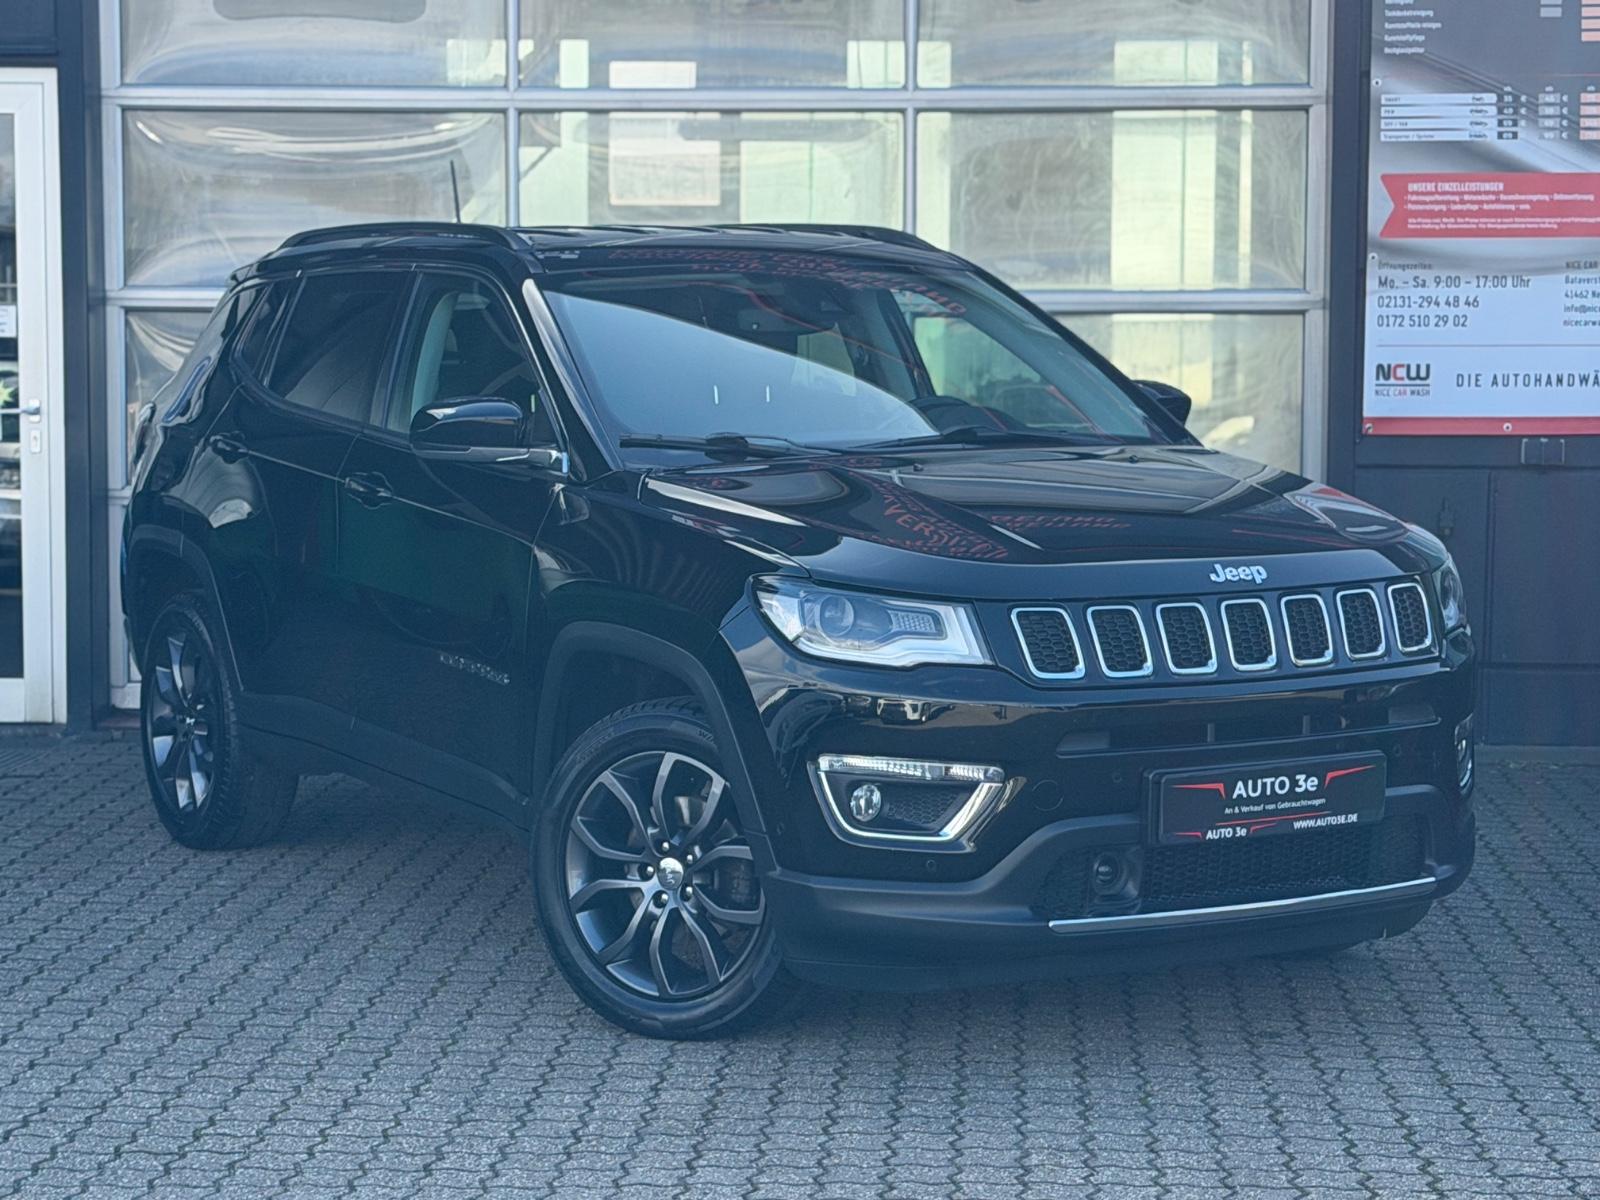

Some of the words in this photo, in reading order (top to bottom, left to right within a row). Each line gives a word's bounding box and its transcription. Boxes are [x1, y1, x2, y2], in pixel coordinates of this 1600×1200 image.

[1378, 275, 1399, 289] Mo.
[1412, 275, 1430, 289] Sa.
[1434, 275, 1462, 289] 9:00
[1475, 275, 1508, 288] 17:00
[1512, 275, 1531, 288] Uhr
[1377, 295, 1441, 309] 02131-294
[1444, 295, 1460, 308] 48
[1464, 295, 1480, 308] 46
[1377, 314, 1405, 328] 0172
[1409, 314, 1430, 328] 510
[1434, 314, 1449, 328] 29
[1453, 314, 1468, 328] 02
[1375, 363, 1431, 381] NCW
[1456, 373, 1482, 388] DIE
[1491, 369, 1600, 388] AUTOHANDWÄ
[1375, 388, 1391, 397] NICE
[1393, 388, 1408, 397] CAR
[1410, 388, 1431, 397] WASH
[1209, 563, 1268, 584] Jeep
[1232, 776, 1290, 799] AUTO
[1294, 774, 1319, 793] 3e
[1224, 807, 1233, 815] An
[1234, 806, 1240, 814] &
[1240, 803, 1264, 813] Verkauf
[1265, 802, 1276, 811] von
[1277, 797, 1326, 810] Gebrauchtwagen
[1293, 813, 1358, 830] WWW.AUTO3E.DE
[1206, 827, 1233, 840] AUTO
[1235, 826, 1247, 837] 3e
